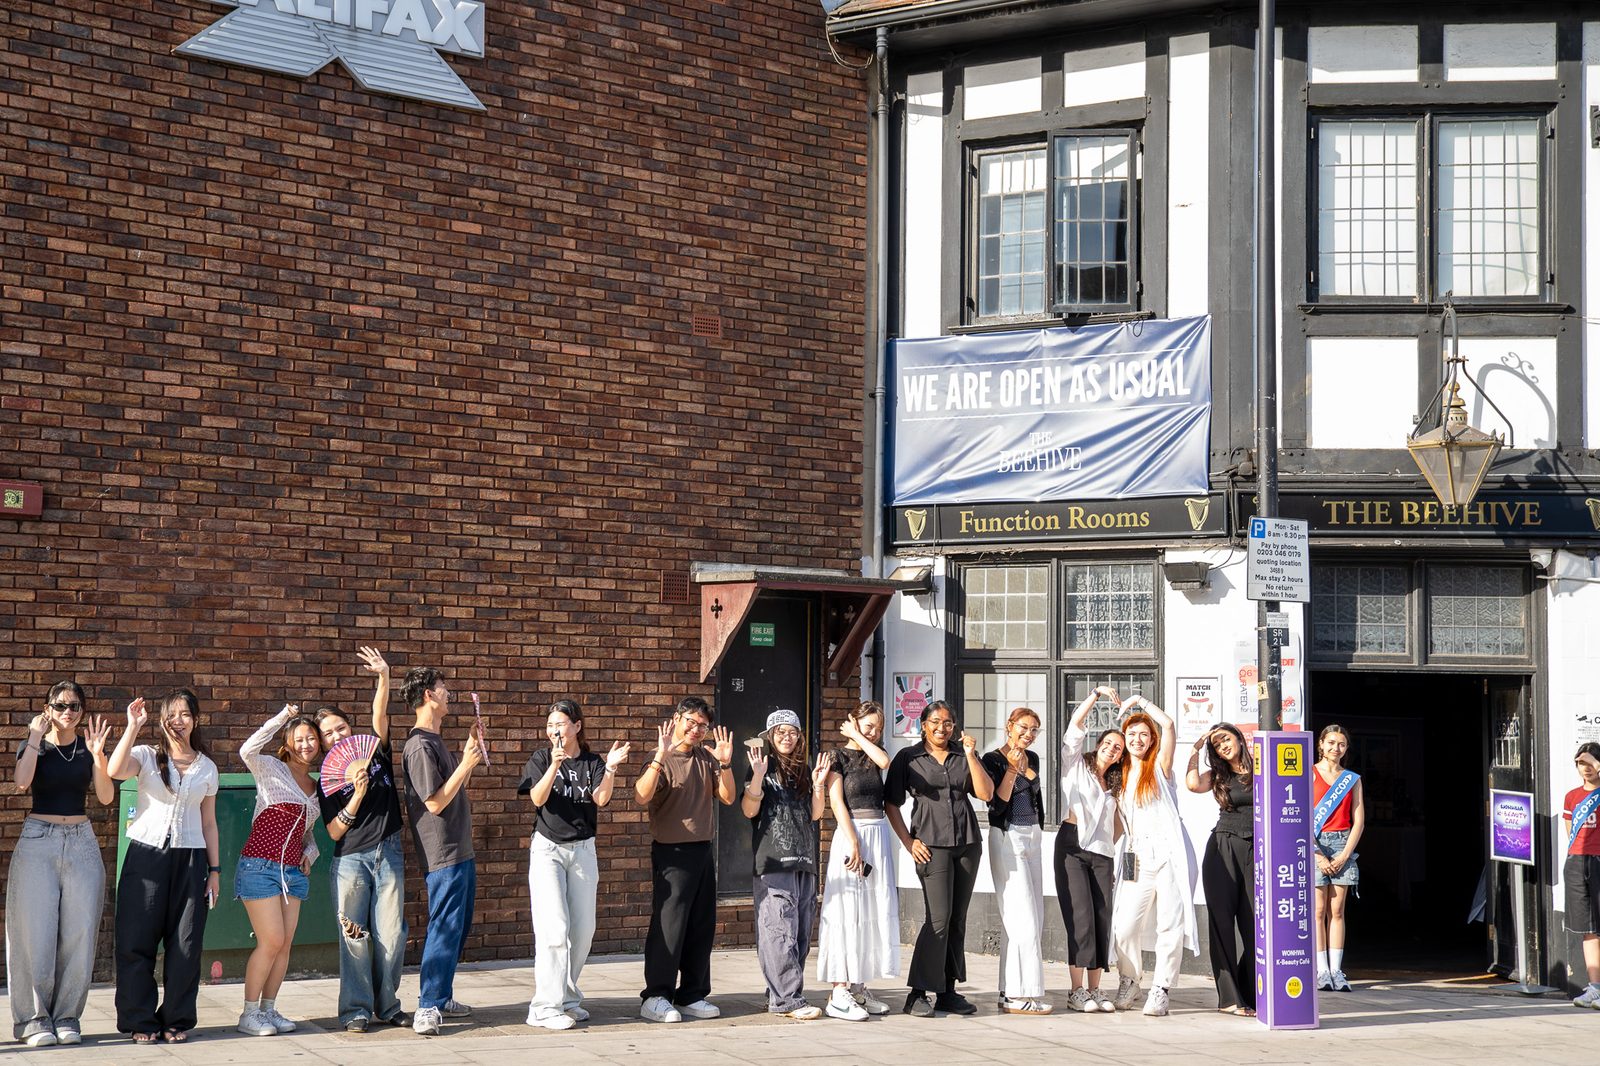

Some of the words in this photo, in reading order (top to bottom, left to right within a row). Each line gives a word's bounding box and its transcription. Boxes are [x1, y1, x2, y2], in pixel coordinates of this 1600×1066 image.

[237, 0, 481, 54] LIFAX
[903, 374, 938, 412] WE
[945, 370, 992, 410] ARE
[1000, 366, 1061, 407] OPEN
[1068, 363, 1103, 403] AS
[1108, 356, 1191, 400] USUAL
[1029, 431, 1052, 447] THE
[997, 447, 1082, 473] BEEHIVE
[959, 509, 1060, 533] Function
[1068, 506, 1150, 530] Rooms
[1322, 500, 1392, 525] THE
[1400, 501, 1543, 526] BEEHIVE
[1254, 522, 1264, 536] P
[1272, 542, 1280, 550] by
[1281, 543, 1298, 551] phone
[1256, 558, 1279, 566] quoting
[1280, 559, 1302, 567] location
[1272, 629, 1283, 637] SR
[1284, 783, 1297, 805] 1
[1281, 806, 1301, 816] 출입구
[1277, 863, 1296, 922] 원화
[1281, 949, 1305, 957] WONHWA
[1275, 958, 1299, 966] K-Beauty
